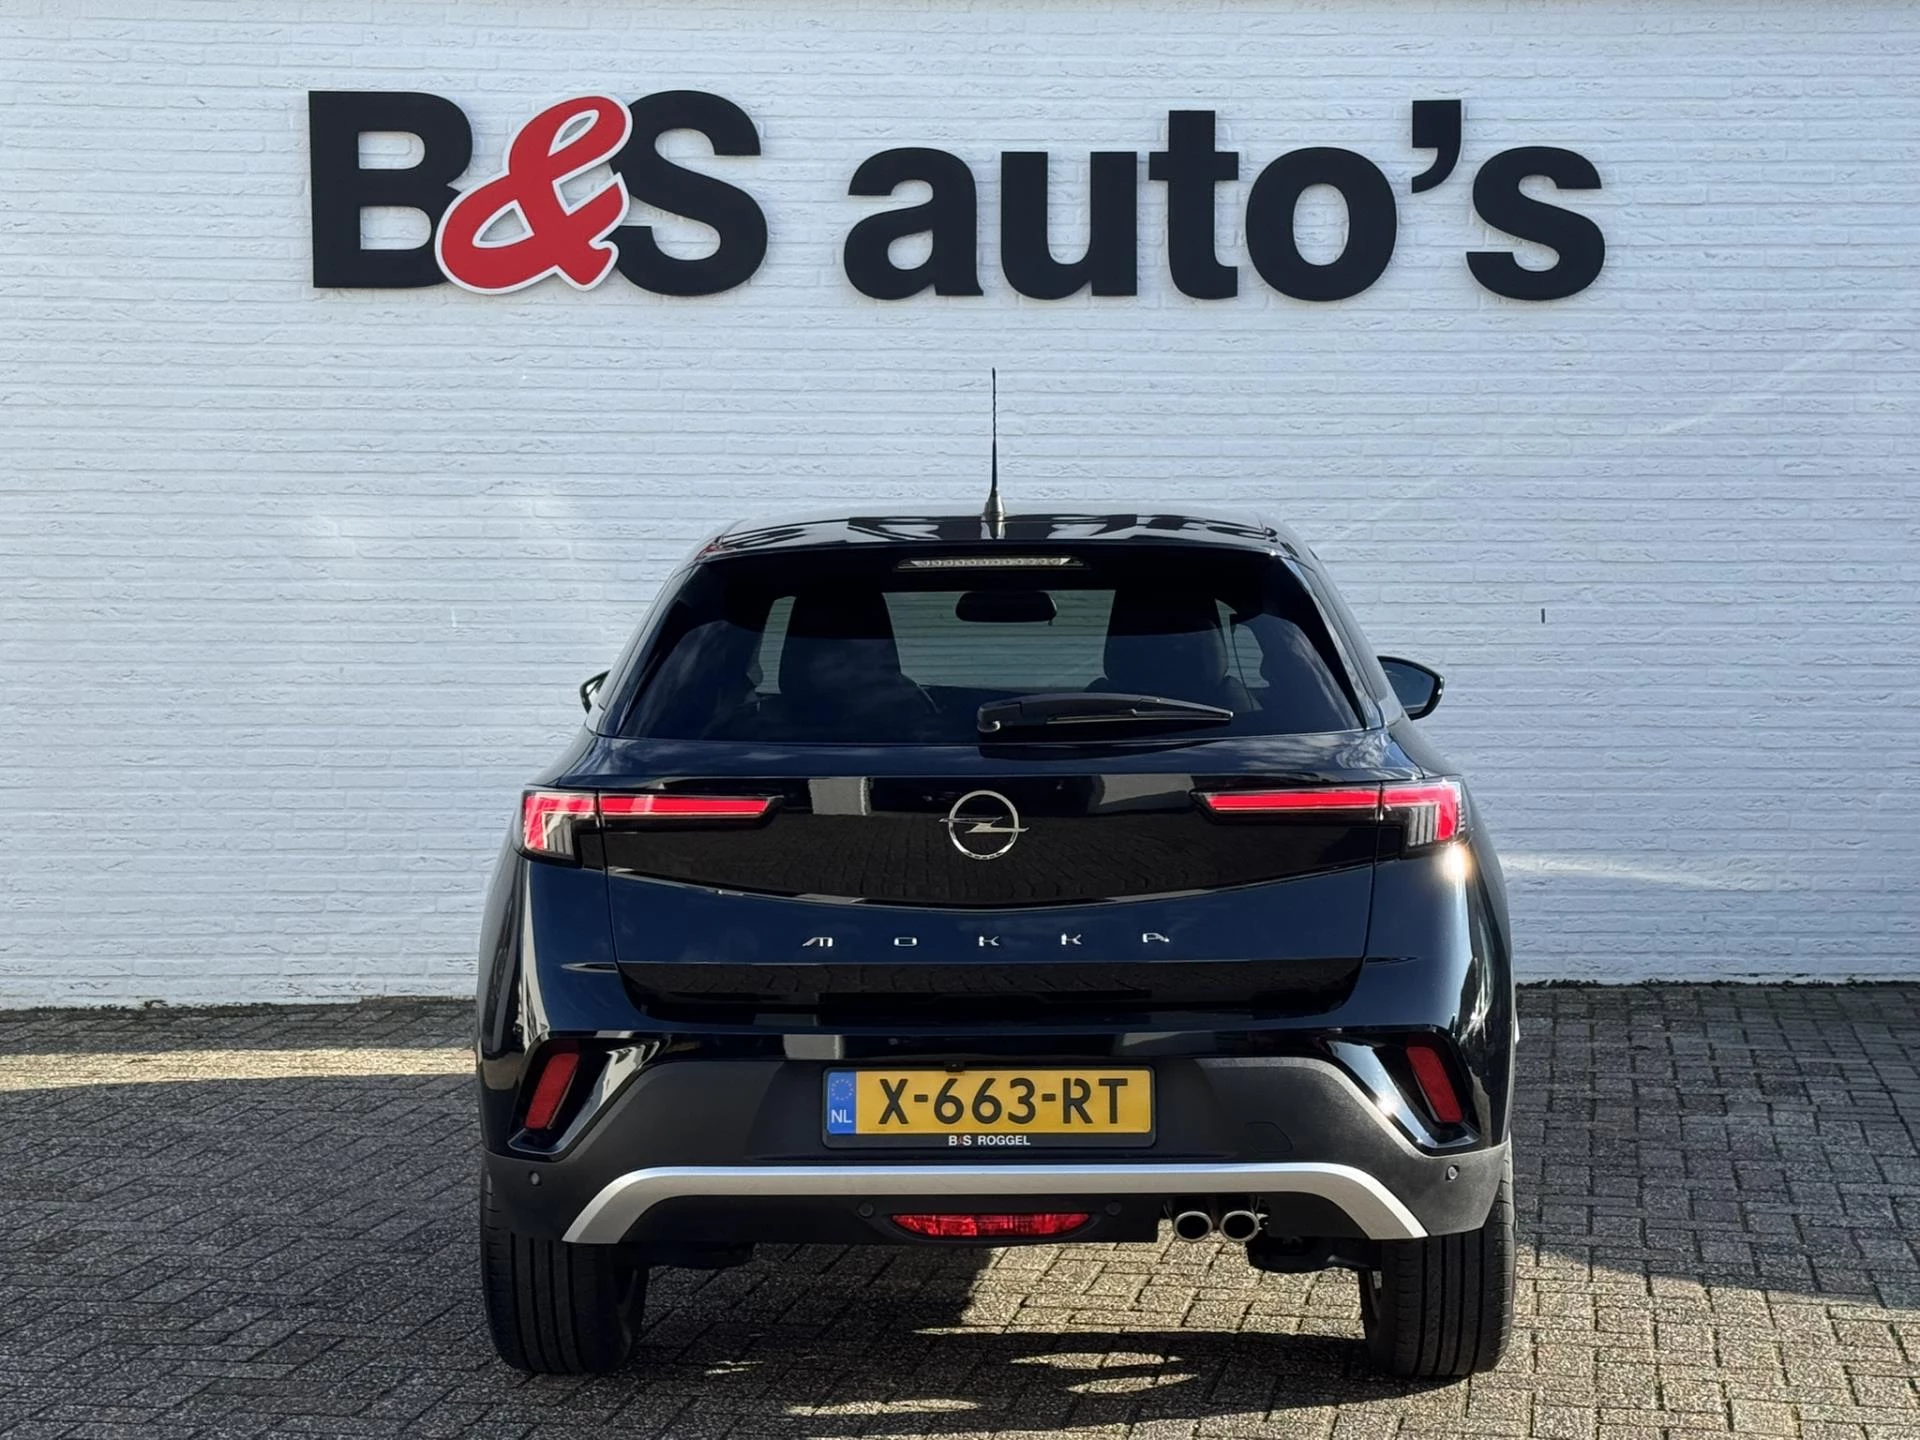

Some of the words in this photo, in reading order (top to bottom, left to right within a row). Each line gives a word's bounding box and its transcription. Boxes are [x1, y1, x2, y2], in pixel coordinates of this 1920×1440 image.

[308, 90, 768, 295] B&S
[831, 1110, 852, 1124] NL
[878, 1078, 1128, 1125] X-663-RT
[977, 1136, 1031, 1146] ROGGEL
